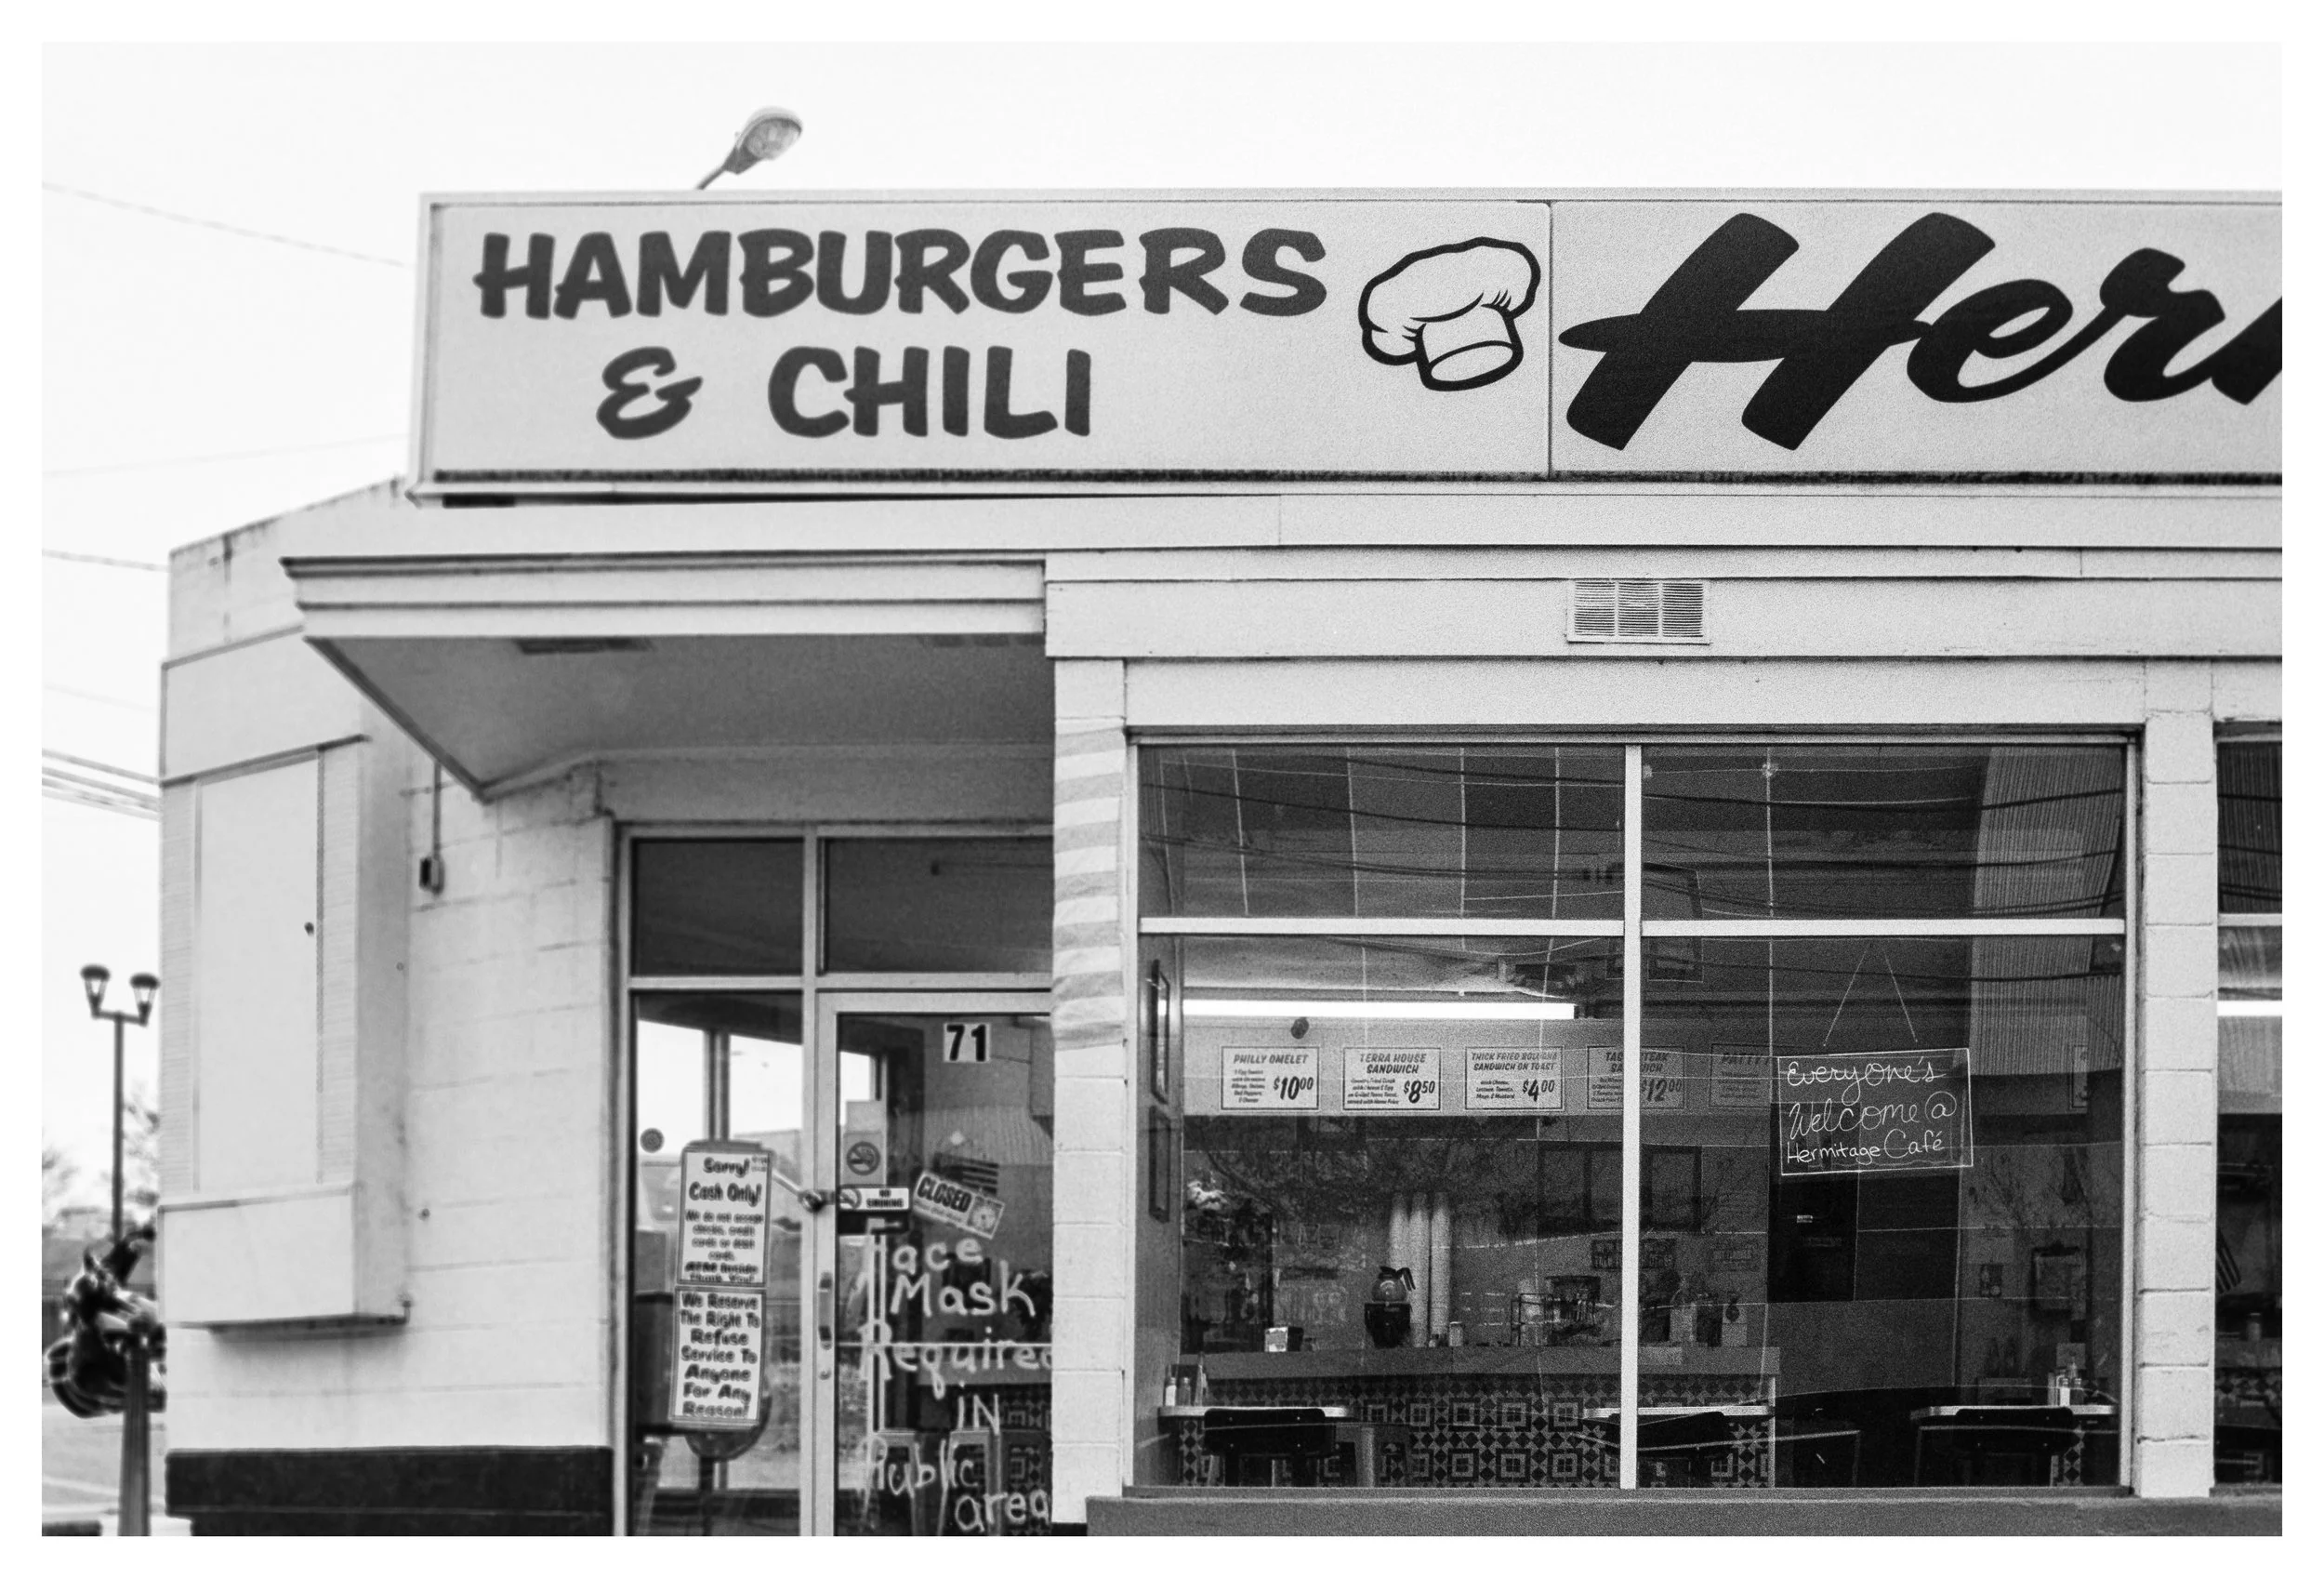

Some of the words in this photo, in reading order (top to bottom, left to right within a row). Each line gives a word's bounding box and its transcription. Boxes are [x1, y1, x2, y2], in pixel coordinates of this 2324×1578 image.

[472, 227, 1327, 320] HAMBURGERS
[1558, 211, 2283, 451] Her
[596, 346, 704, 439] &
[767, 345, 1092, 439] CHILI
[946, 1024, 986, 1062] 71
[1233, 1054, 1267, 1064] PHILLY
[1269, 1054, 1309, 1064] OMELET
[1360, 1053, 1391, 1063] TERRA
[1393, 1054, 1426, 1063] HOUSE
[1472, 1052, 1496, 1060] THICK
[1497, 1052, 1520, 1061] FRIED
[1473, 1063, 1516, 1071] SANDWICH
[1530, 1063, 1556, 1071] TOAST
[1367, 1064, 1419, 1074] SANDWICH
[1787, 1056, 1948, 1107] Everyone's
[1789, 1097, 1921, 1140] Welcome
[1924, 1090, 1958, 1123] @
[1787, 1141, 1882, 1166] Hermitage
[1883, 1128, 1946, 1159] Café
[703, 1156, 750, 1178] Sorry!
[688, 1181, 724, 1201] Cash
[726, 1182, 762, 1207] Only!
[917, 1175, 972, 1213] CLOSED
[681, 1293, 704, 1308] We
[707, 1293, 759, 1309] Reserve
[889, 1259, 1037, 1319] Mask
[680, 1308, 702, 1326] The
[706, 1310, 742, 1331] Right
[746, 1311, 760, 1329] To
[690, 1327, 749, 1346] Refuse
[680, 1345, 735, 1363] Service
[740, 1347, 758, 1364] To
[684, 1363, 751, 1385] Anyone
[683, 1381, 712, 1398] For
[718, 1384, 752, 1406] Any
